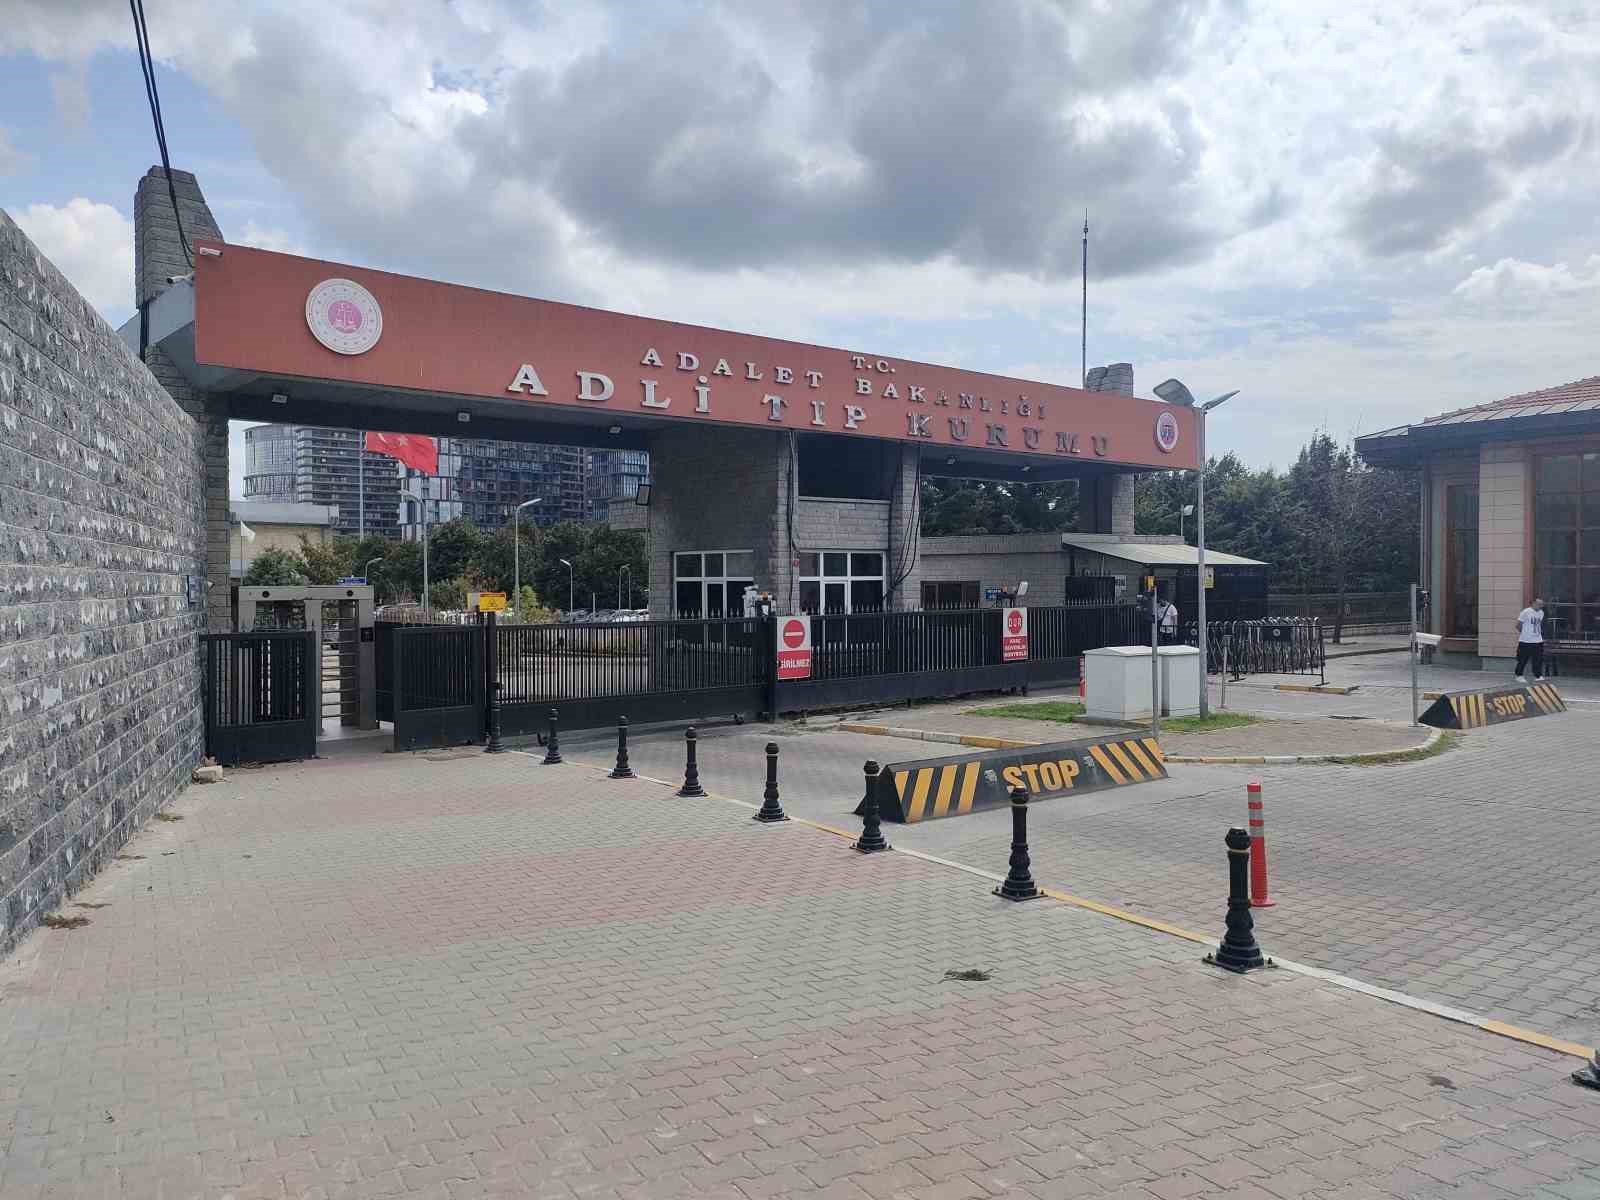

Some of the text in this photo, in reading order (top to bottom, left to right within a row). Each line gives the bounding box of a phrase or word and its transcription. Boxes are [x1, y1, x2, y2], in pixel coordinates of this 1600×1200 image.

[852, 356, 896, 373] T.C.
[641, 348, 1047, 420] ADALET BAKANLIĞI
[507, 364, 1107, 457] ADLİ TIP KURUMU
[1493, 694, 1525, 716] STOP
[1002, 759, 1080, 793] STOP
